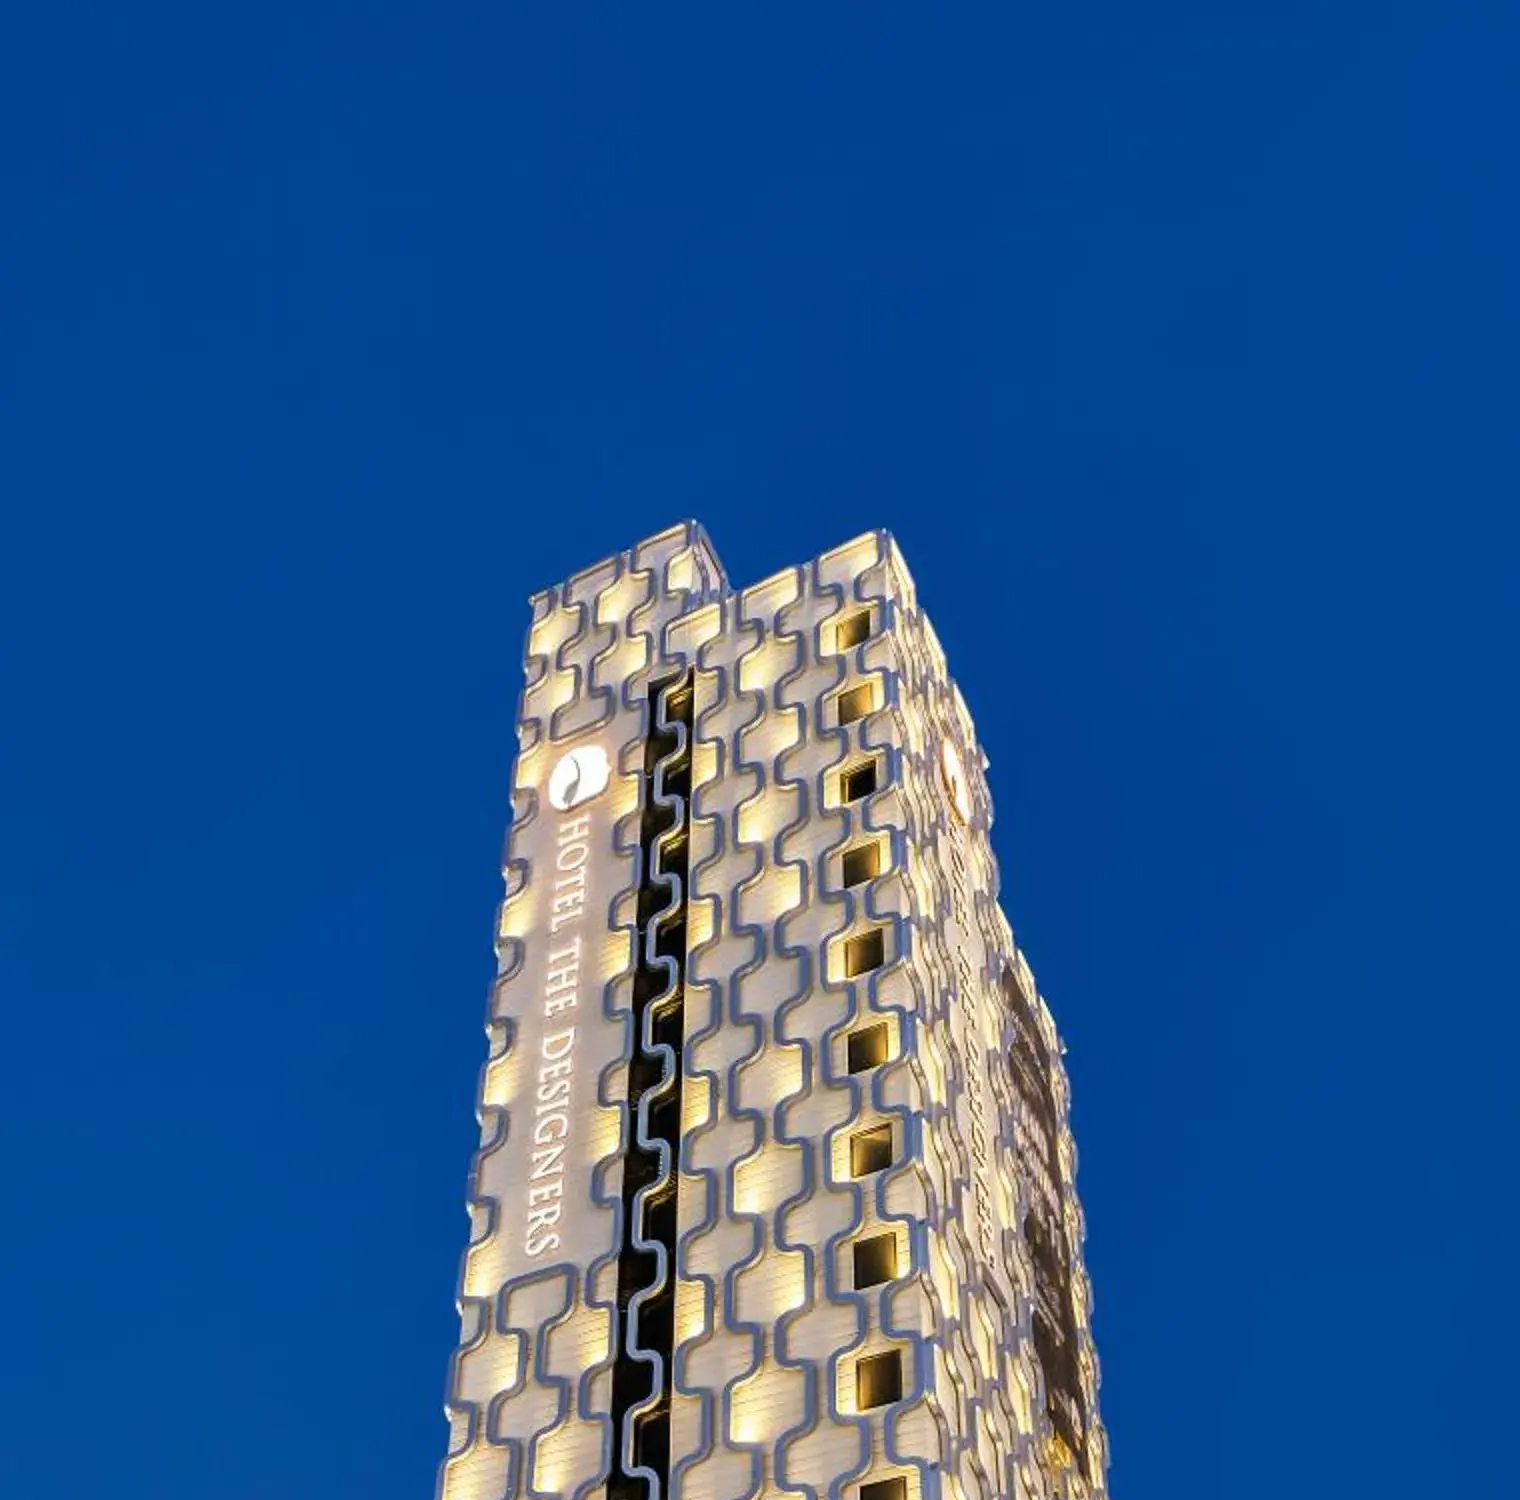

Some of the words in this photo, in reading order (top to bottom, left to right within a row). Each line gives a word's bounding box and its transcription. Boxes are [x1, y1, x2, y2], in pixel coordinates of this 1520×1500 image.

[550, 814, 590, 933] HOTEL
[544, 937, 582, 1017] THE
[524, 1027, 577, 1258] DESIGNERS
